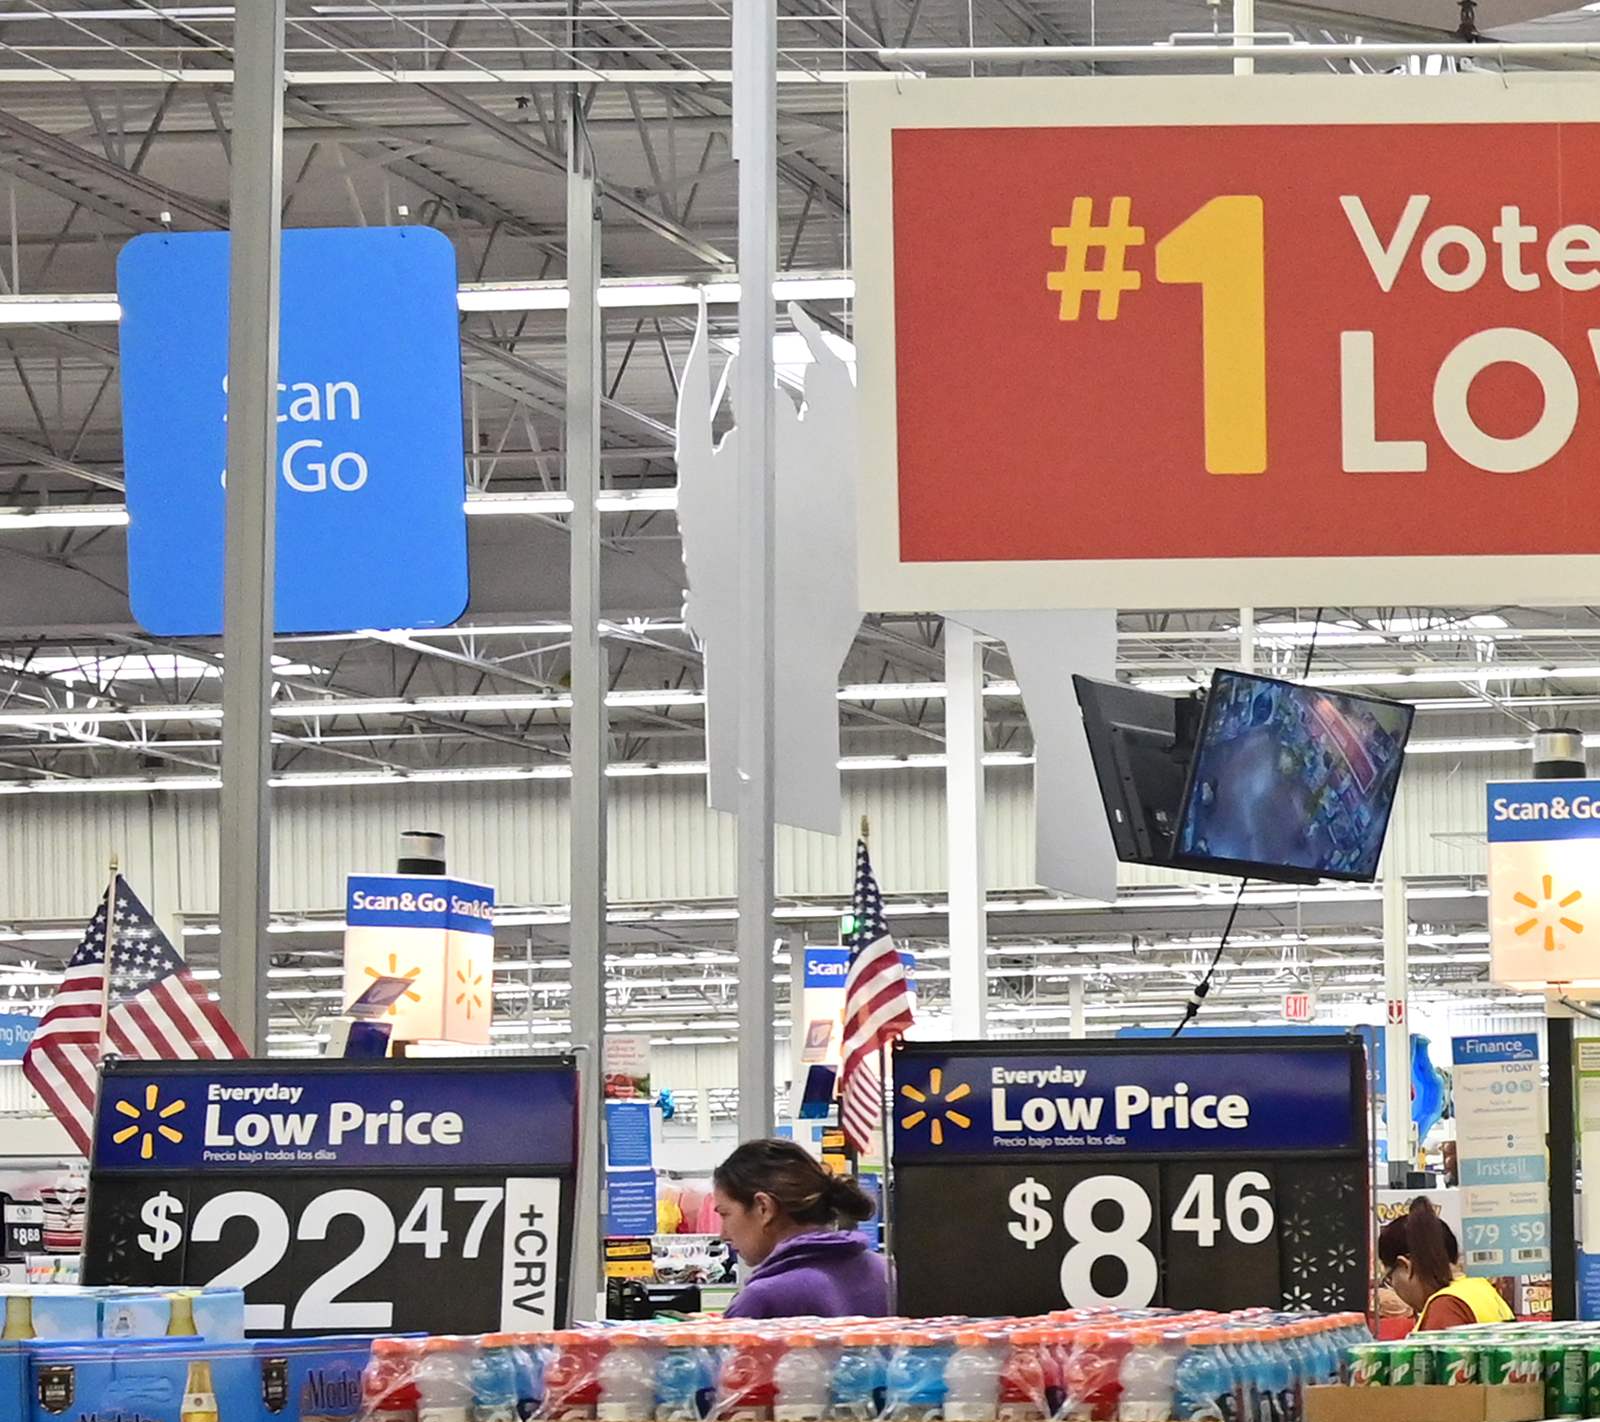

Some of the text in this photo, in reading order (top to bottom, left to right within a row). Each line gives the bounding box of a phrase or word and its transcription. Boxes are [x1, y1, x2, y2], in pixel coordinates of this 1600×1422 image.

[1046, 194, 1266, 475] #1
[222, 374, 361, 424] can
[282, 441, 368, 492] Go
[353, 890, 447, 912] Scan&Go
[1286, 996, 1309, 1018] EXIT
[1466, 1039, 1523, 1054] Finance
[991, 1066, 1087, 1090] Everyday
[1500, 1064, 1534, 1074] TODAY
[208, 1084, 304, 1104] Everyday
[992, 1082, 1250, 1133] Low Price
[204, 1101, 464, 1147] Low Price
[993, 1135, 1026, 1146] Precio
[1029, 1135, 1052, 1148] bajo
[1054, 1135, 1084, 1146] todos
[1086, 1135, 1100, 1146] los
[203, 1150, 236, 1161] Precio
[238, 1150, 262, 1163] bajo
[264, 1150, 296, 1161] todos
[298, 1150, 312, 1161] los
[1476, 1159, 1527, 1177] Install
[1466, 1221, 1545, 1245] $79 $59
[513, 1203, 549, 1316] +CRV
